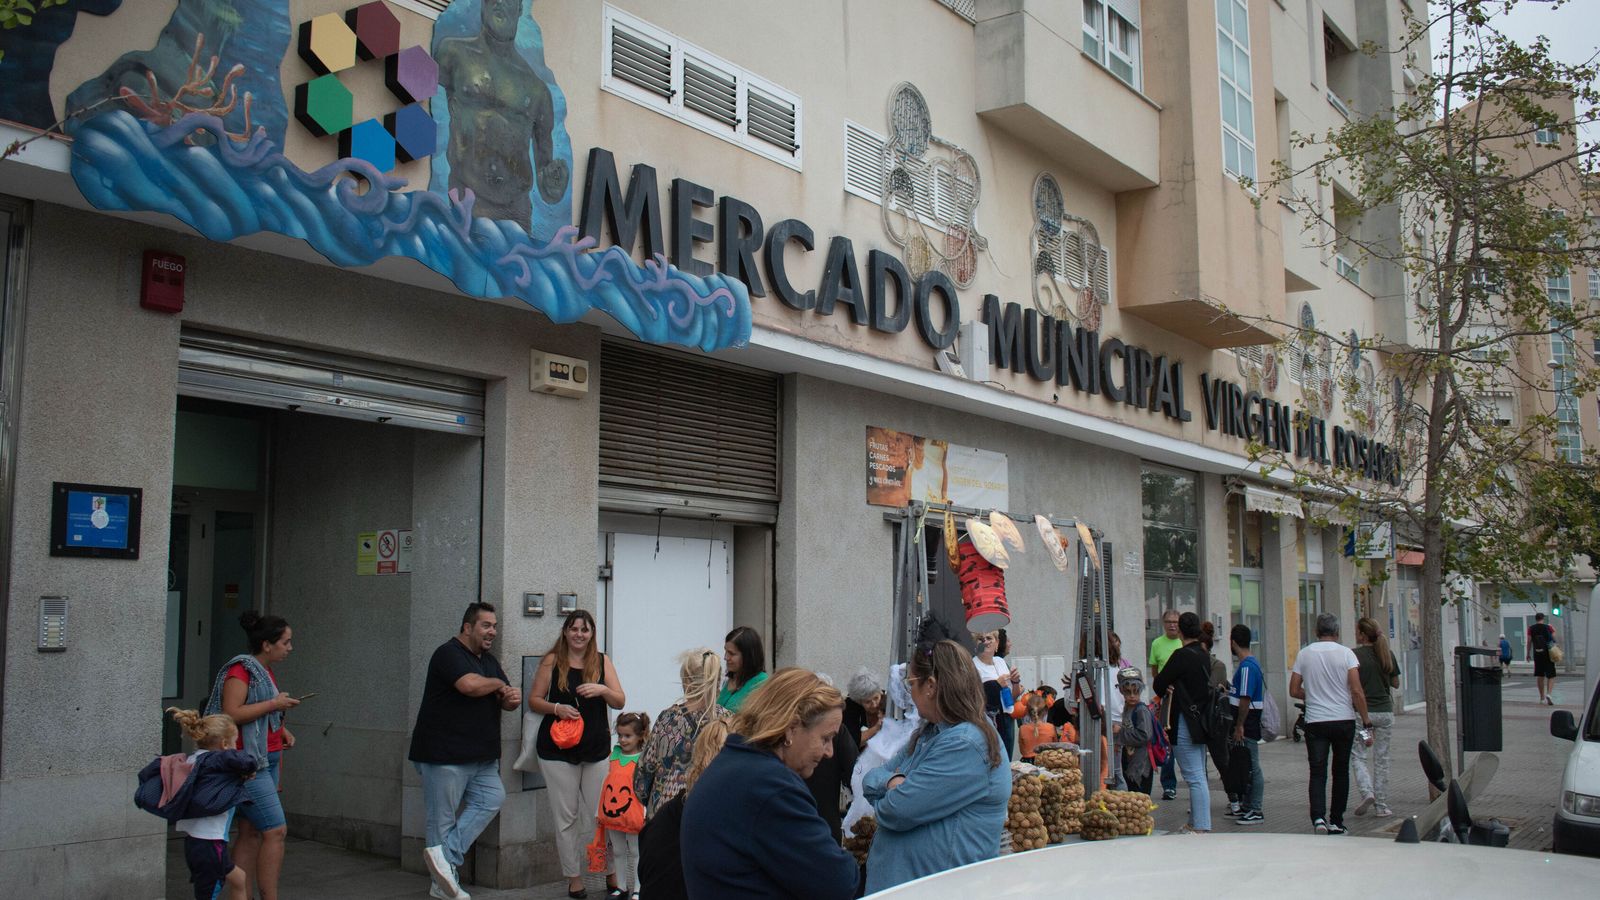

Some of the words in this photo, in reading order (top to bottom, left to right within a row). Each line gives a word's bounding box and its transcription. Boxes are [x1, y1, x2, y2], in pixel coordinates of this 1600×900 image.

[152, 258, 184, 273] FUEGO
[578, 147, 960, 349] MERCADO
[982, 293, 1192, 422] MUNICIPAL
[1200, 373, 1291, 453] VIRGEN
[1296, 411, 1331, 465] DEL
[869, 441, 889, 452] FRUTAS
[869, 451, 890, 462] CARNES
[869, 461, 896, 473] PESCADOS
